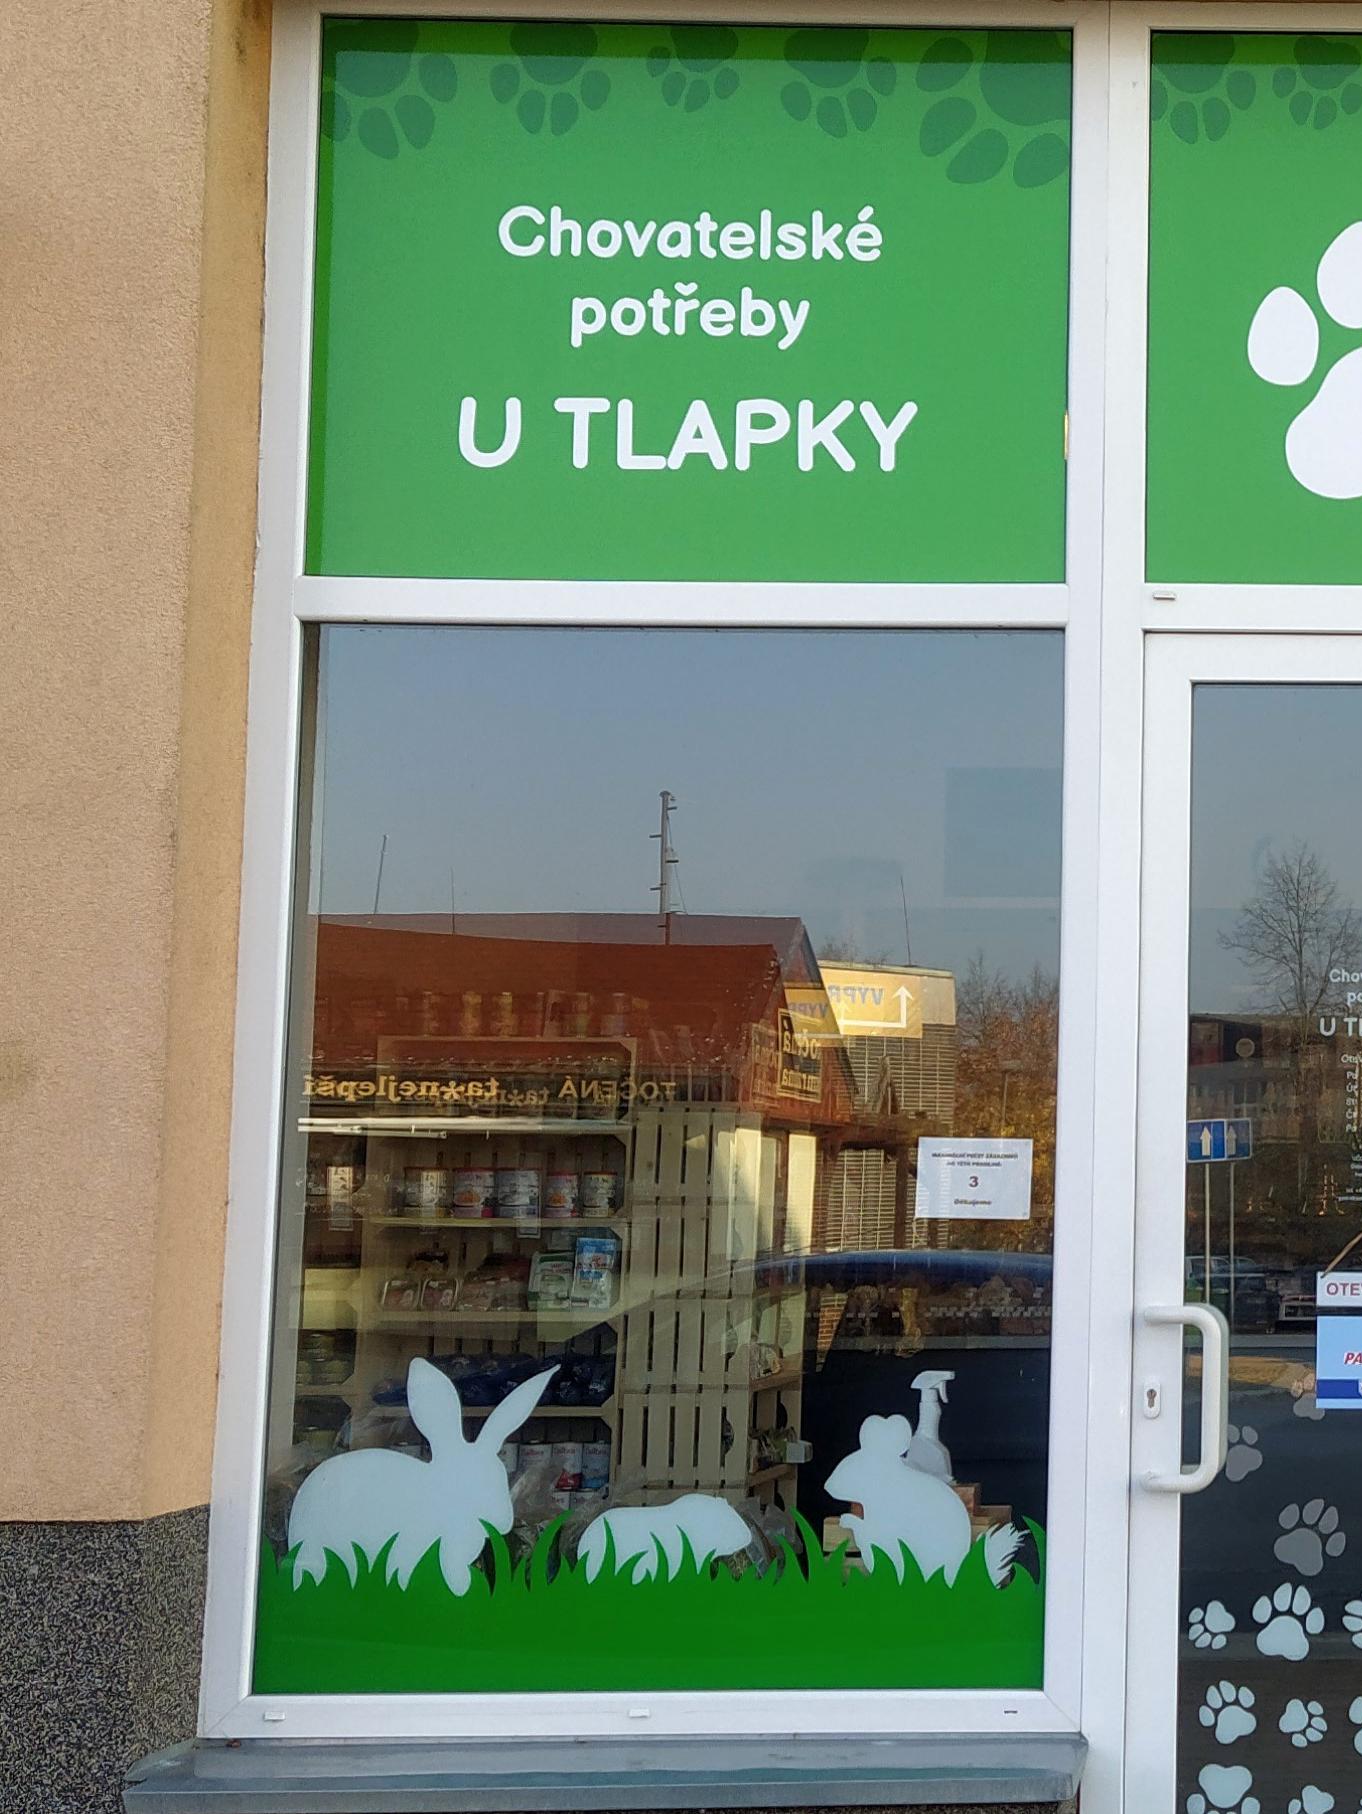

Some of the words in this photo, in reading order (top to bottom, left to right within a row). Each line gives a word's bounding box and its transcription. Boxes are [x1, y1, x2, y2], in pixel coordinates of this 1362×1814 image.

[498, 205, 883, 262] Chovatelské
[570, 282, 810, 350] potřeby
[458, 396, 522, 468] U
[553, 397, 918, 472] TLAPKY
[1320, 1017, 1336, 1036] U
[968, 1175, 979, 1188] 3
